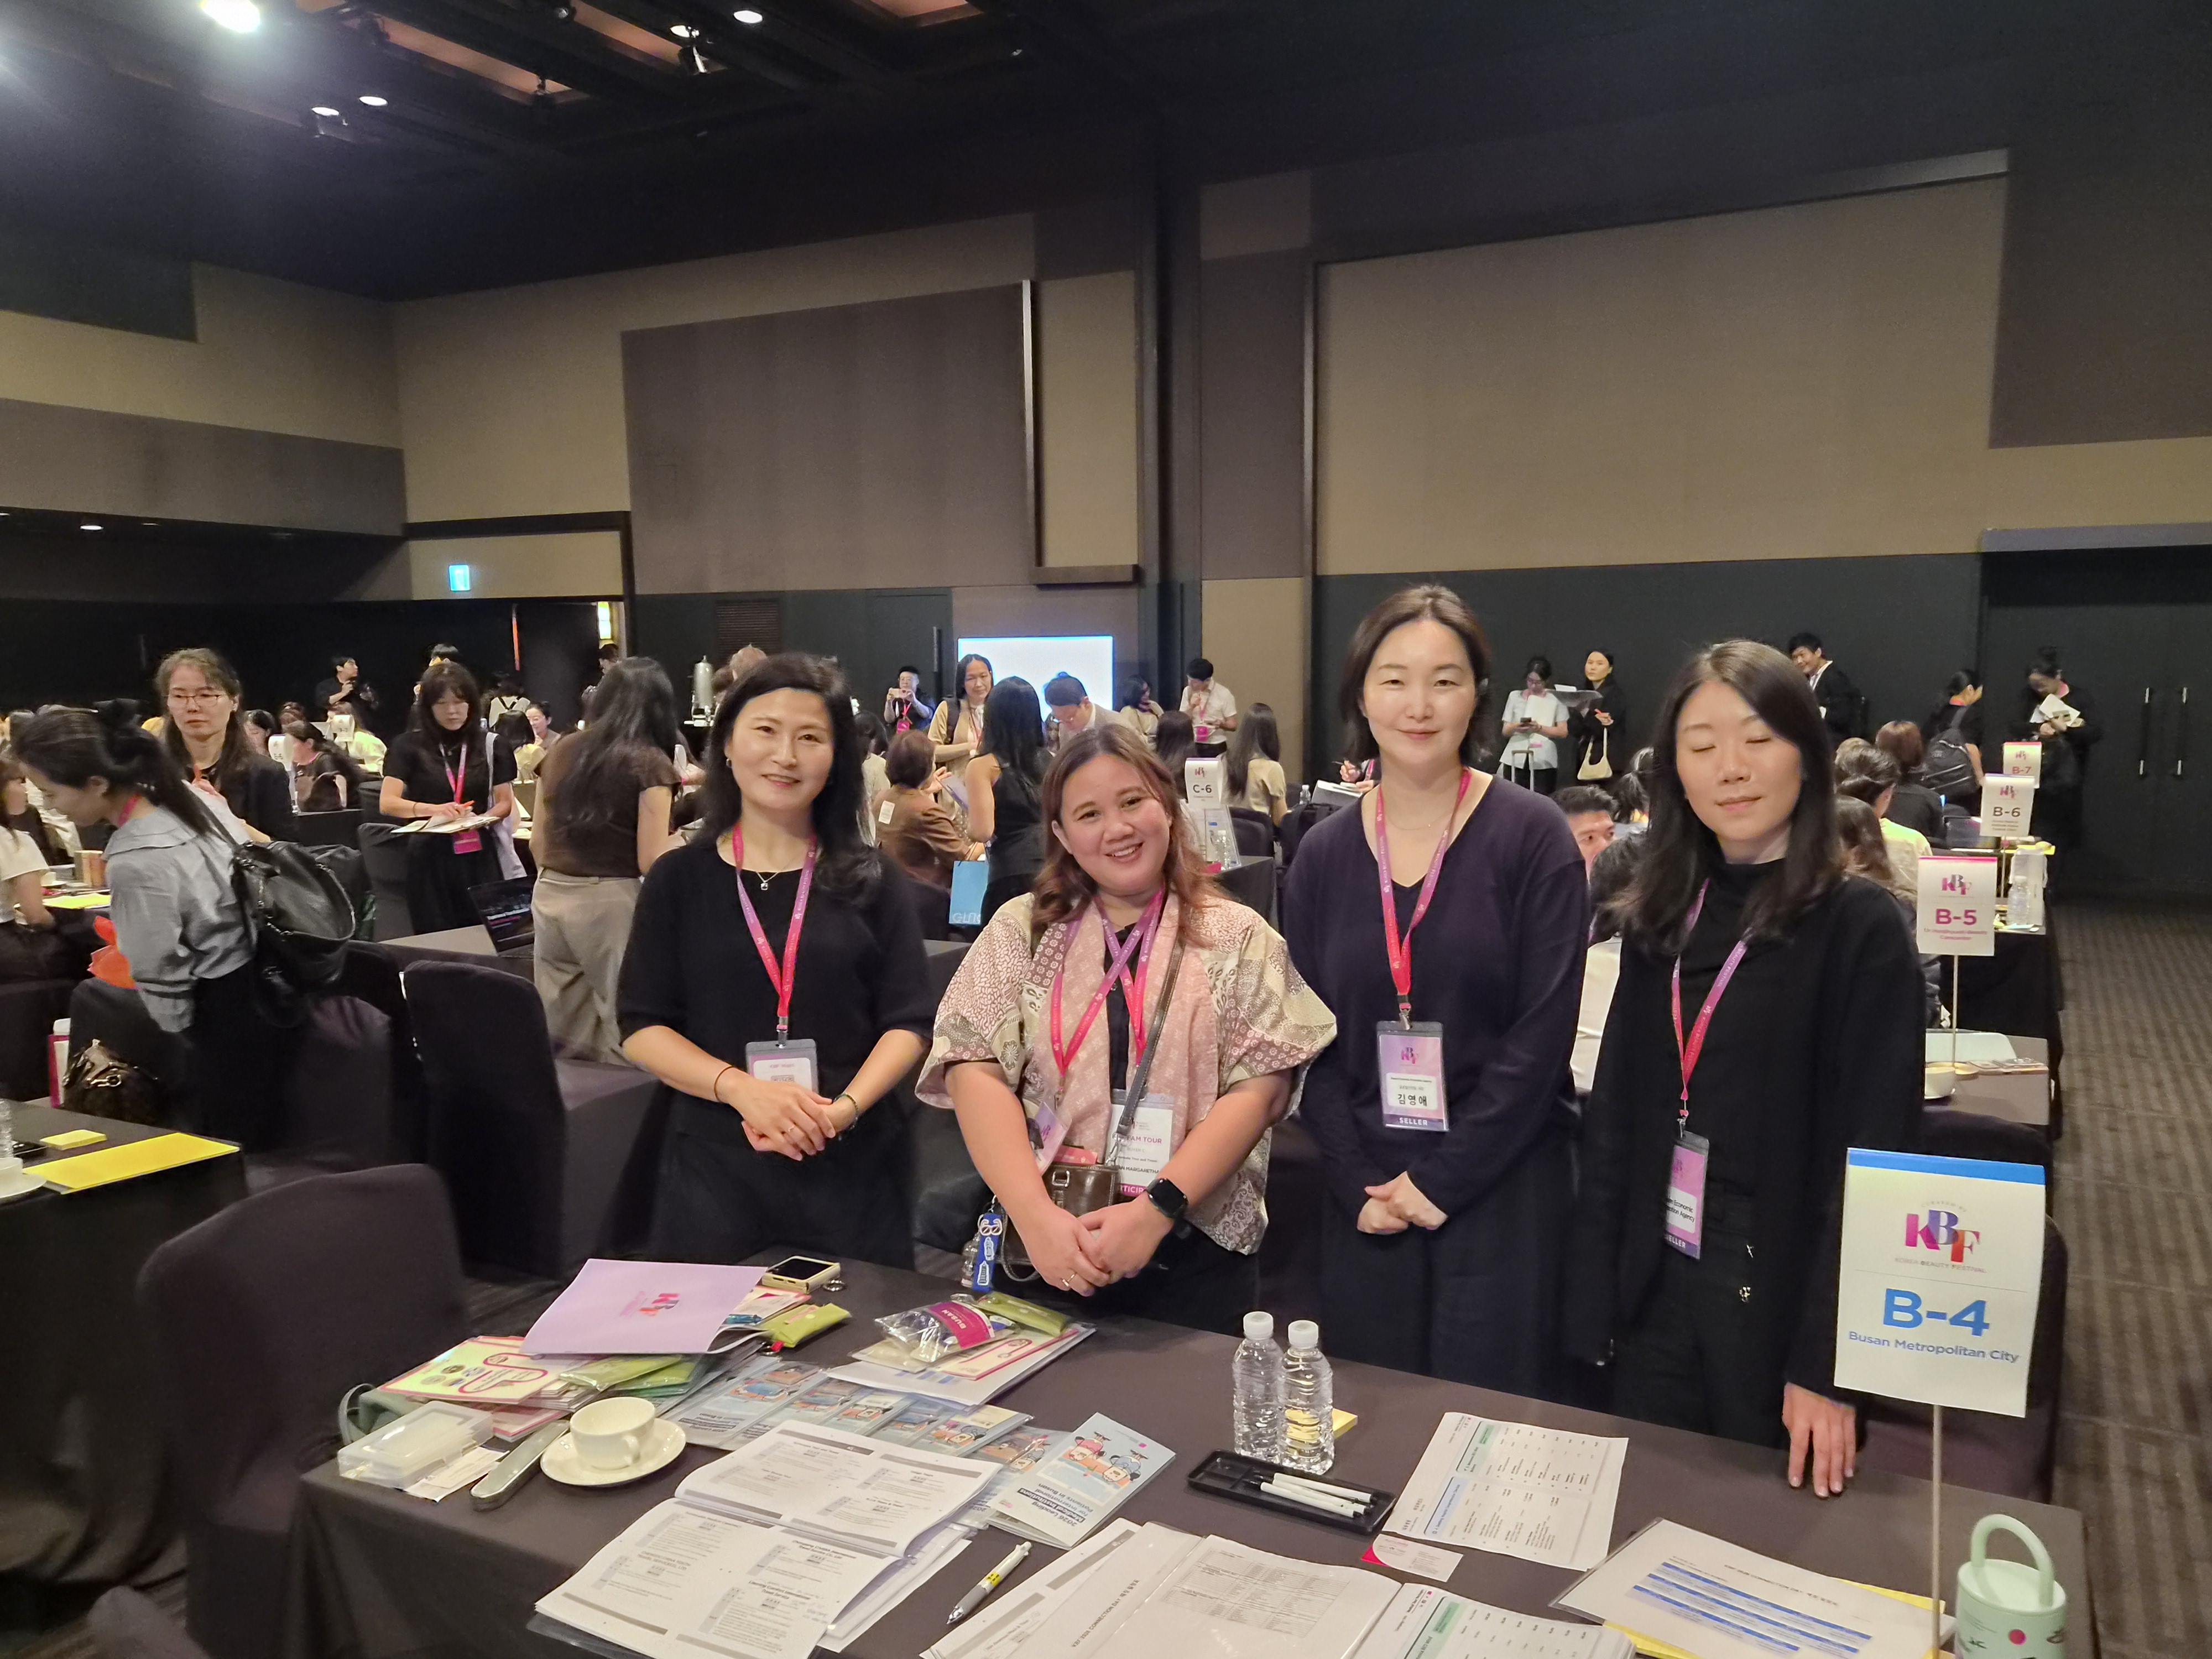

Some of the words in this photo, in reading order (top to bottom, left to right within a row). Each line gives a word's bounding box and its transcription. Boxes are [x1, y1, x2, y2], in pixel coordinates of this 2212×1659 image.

[1193, 785, 1212, 793] C-6
[1993, 807, 2021, 817] B-6
[1936, 909, 1977, 925] B-5
[1399, 1117, 1428, 1125] SELLER
[1905, 1209, 1981, 1262] KBF
[1951, 1264, 1987, 1273] FESTIVAL
[942, 1310, 967, 1329] BUSAN
[1883, 1288, 1990, 1337] B-4
[1849, 1332, 1890, 1347] Busan
[1895, 1339, 1985, 1359] Metropolitan
[1990, 1350, 2019, 1363] City
[1038, 1482, 1058, 1495] Busan
[1019, 1488, 1056, 1509] Institutions
[1035, 1485, 1077, 1514] International
[1066, 1496, 1094, 1513] Patients
[1031, 1499, 1059, 1518] Leading
[1055, 1505, 1084, 1522] Medical
[1057, 1514, 1077, 1528] 2026
[1088, 1605, 1114, 1631] CONNECTION
